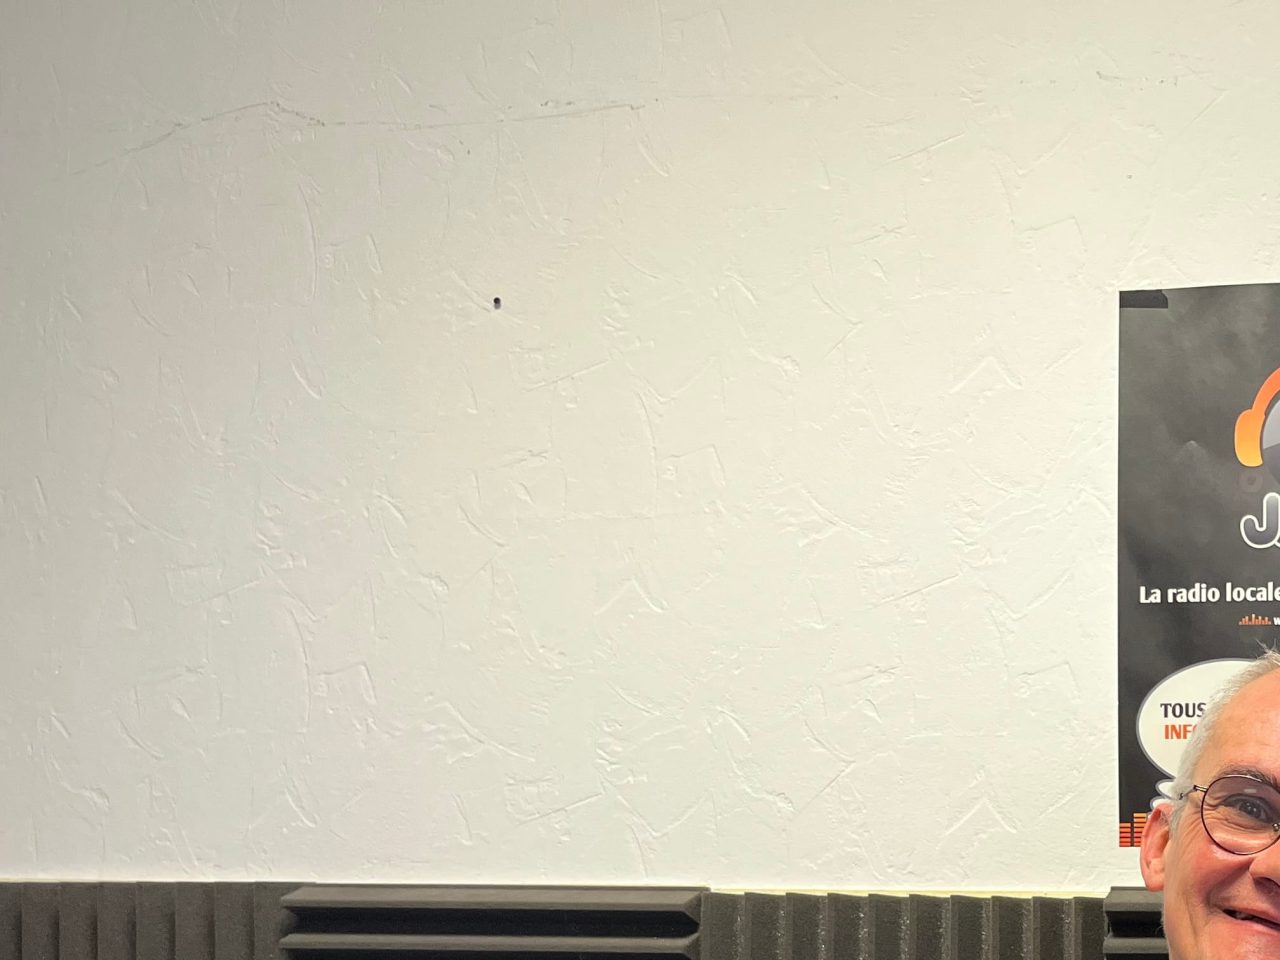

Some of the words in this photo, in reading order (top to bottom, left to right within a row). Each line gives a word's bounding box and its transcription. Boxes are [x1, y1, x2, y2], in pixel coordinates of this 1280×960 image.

[1139, 586, 1162, 603] La
[1167, 583, 1220, 603] radio
[1160, 702, 1207, 718] TOUS
[1164, 724, 1197, 740] INF
